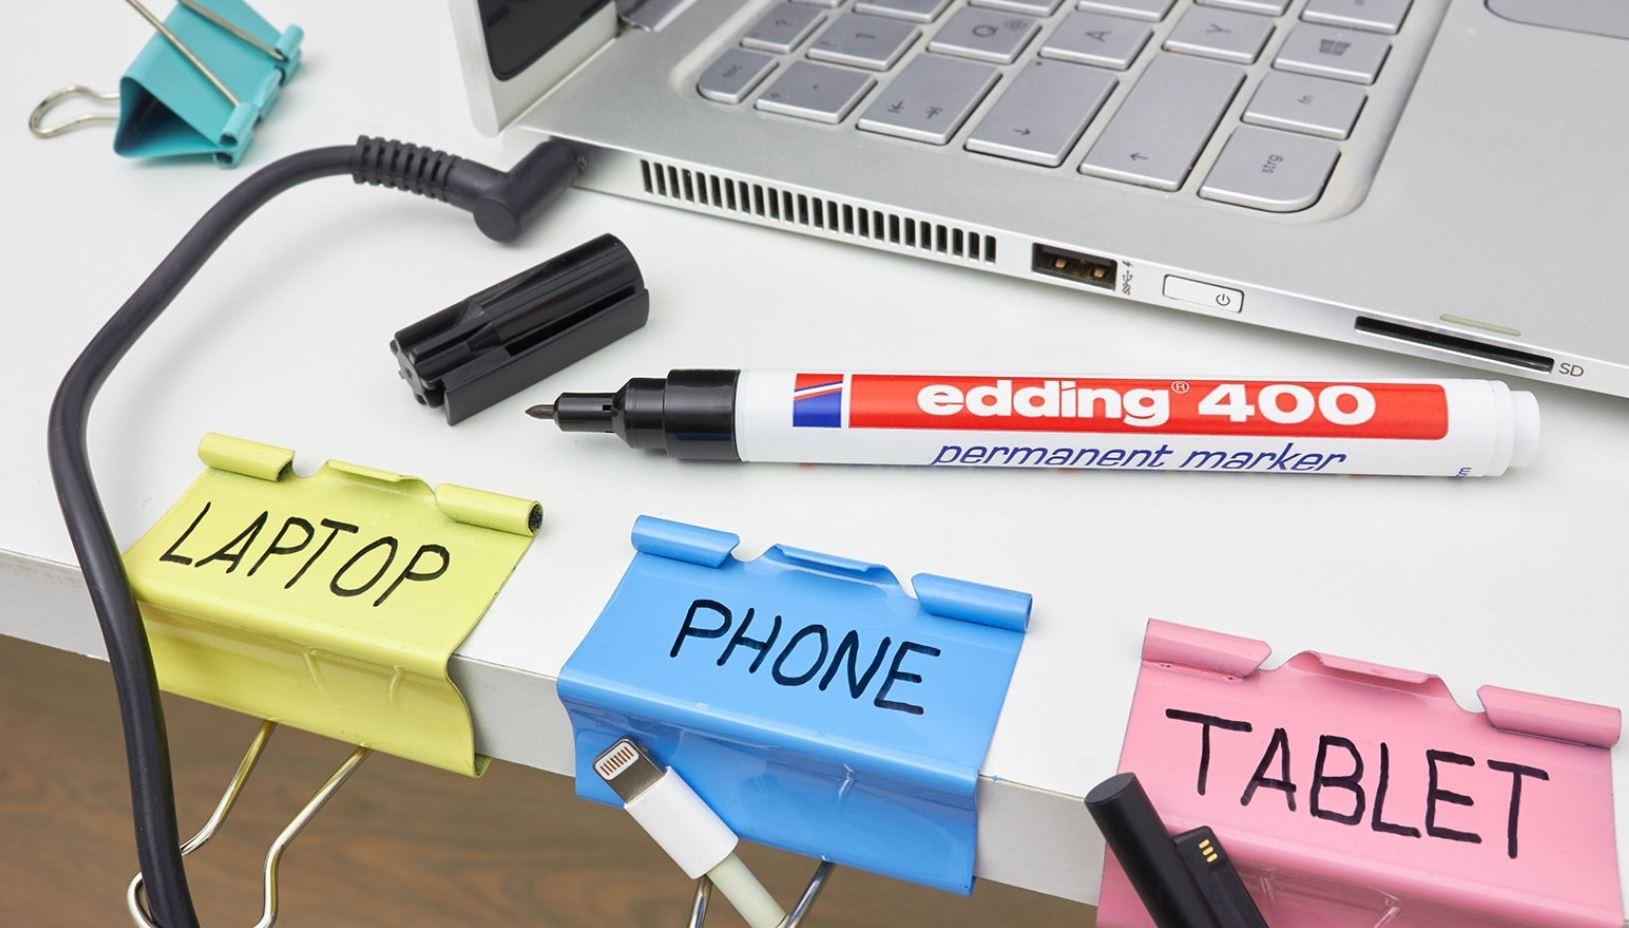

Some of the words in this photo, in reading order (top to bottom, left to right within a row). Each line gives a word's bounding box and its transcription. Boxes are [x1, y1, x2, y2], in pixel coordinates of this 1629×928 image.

[1085, 30, 1112, 43] A
[1204, 23, 1232, 34] Y
[1261, 153, 1284, 174] strg
[1558, 362, 1585, 378] SD
[1198, 383, 1376, 425] 400
[930, 444, 1174, 468] permanent
[1179, 442, 1348, 471] marker
[159, 501, 450, 608] LAPTOP
[669, 599, 941, 716] PHONE
[1165, 708, 1549, 860] TABLET
